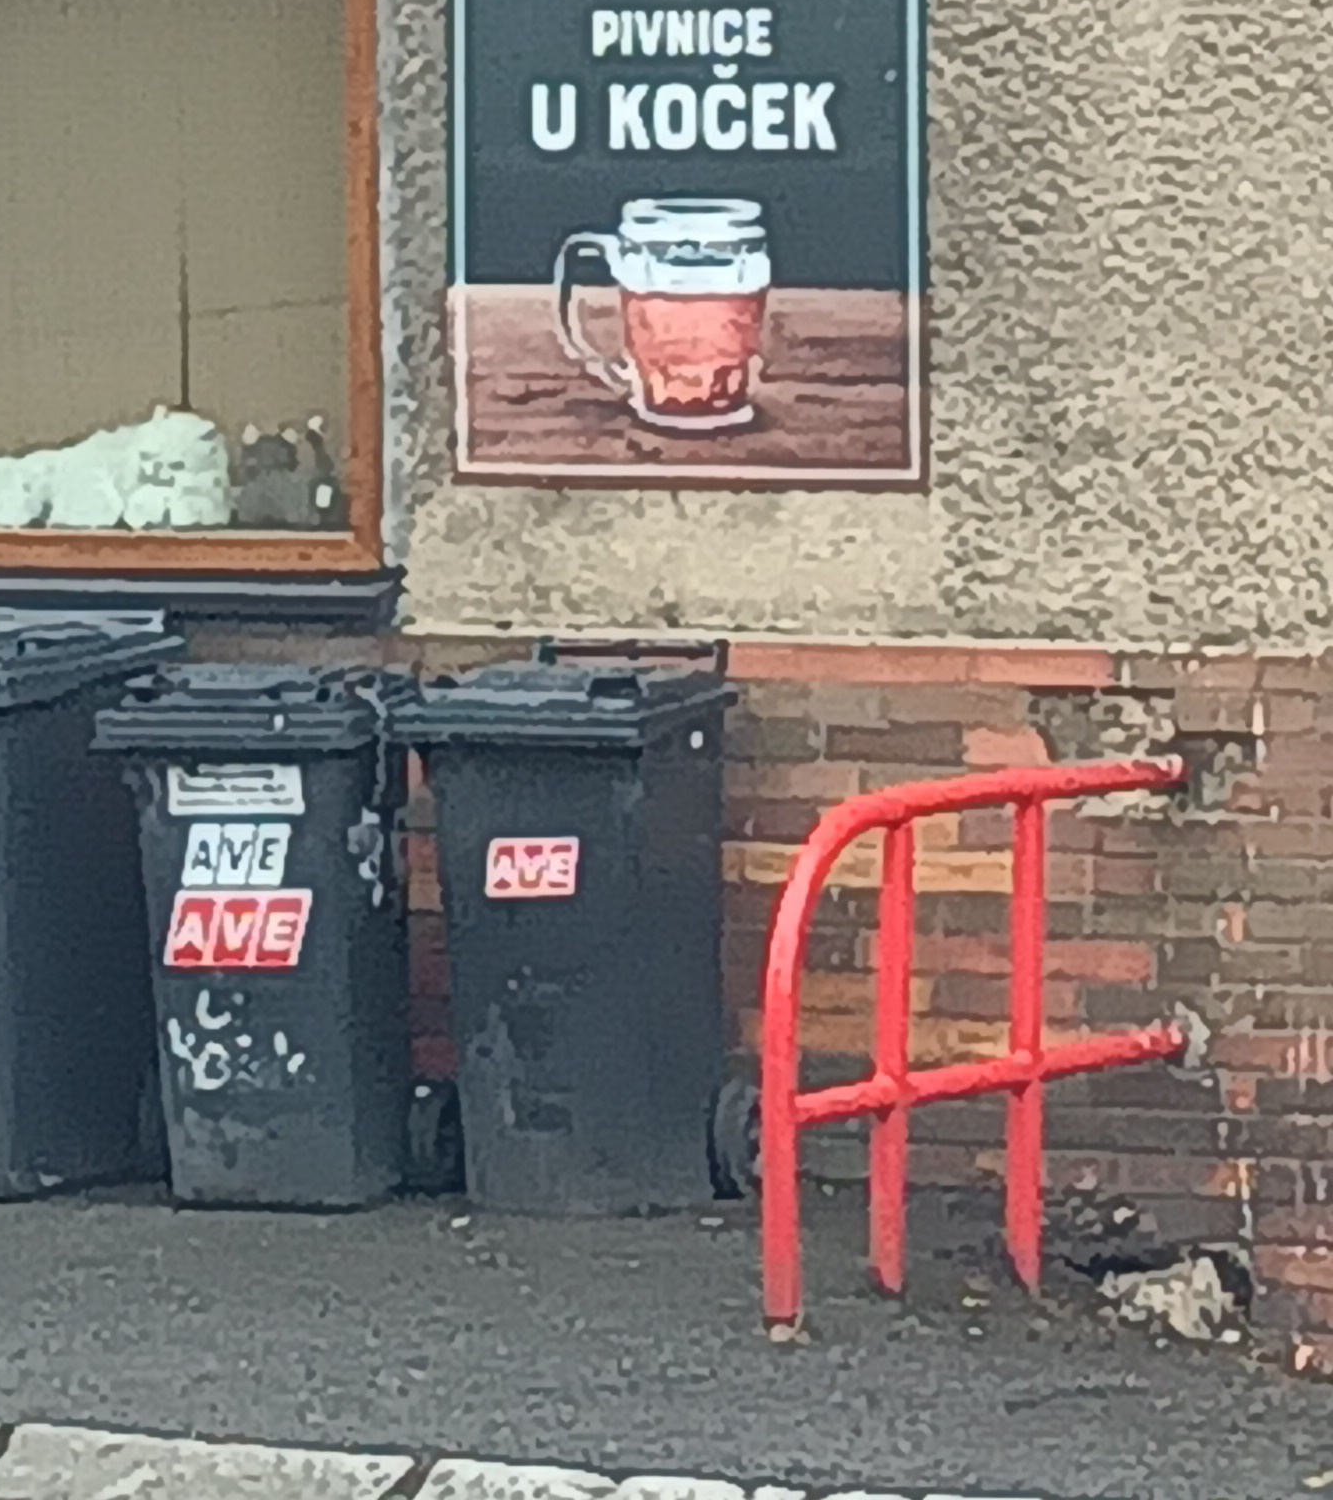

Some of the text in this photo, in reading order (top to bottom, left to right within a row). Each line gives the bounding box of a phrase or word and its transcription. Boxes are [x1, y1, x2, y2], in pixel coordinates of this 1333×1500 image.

[592, 8, 773, 57] PIVNICE
[531, 63, 837, 151] U KOČEK
[189, 835, 282, 873] AVE
[490, 850, 572, 887] AVE
[173, 909, 301, 953] AVE
